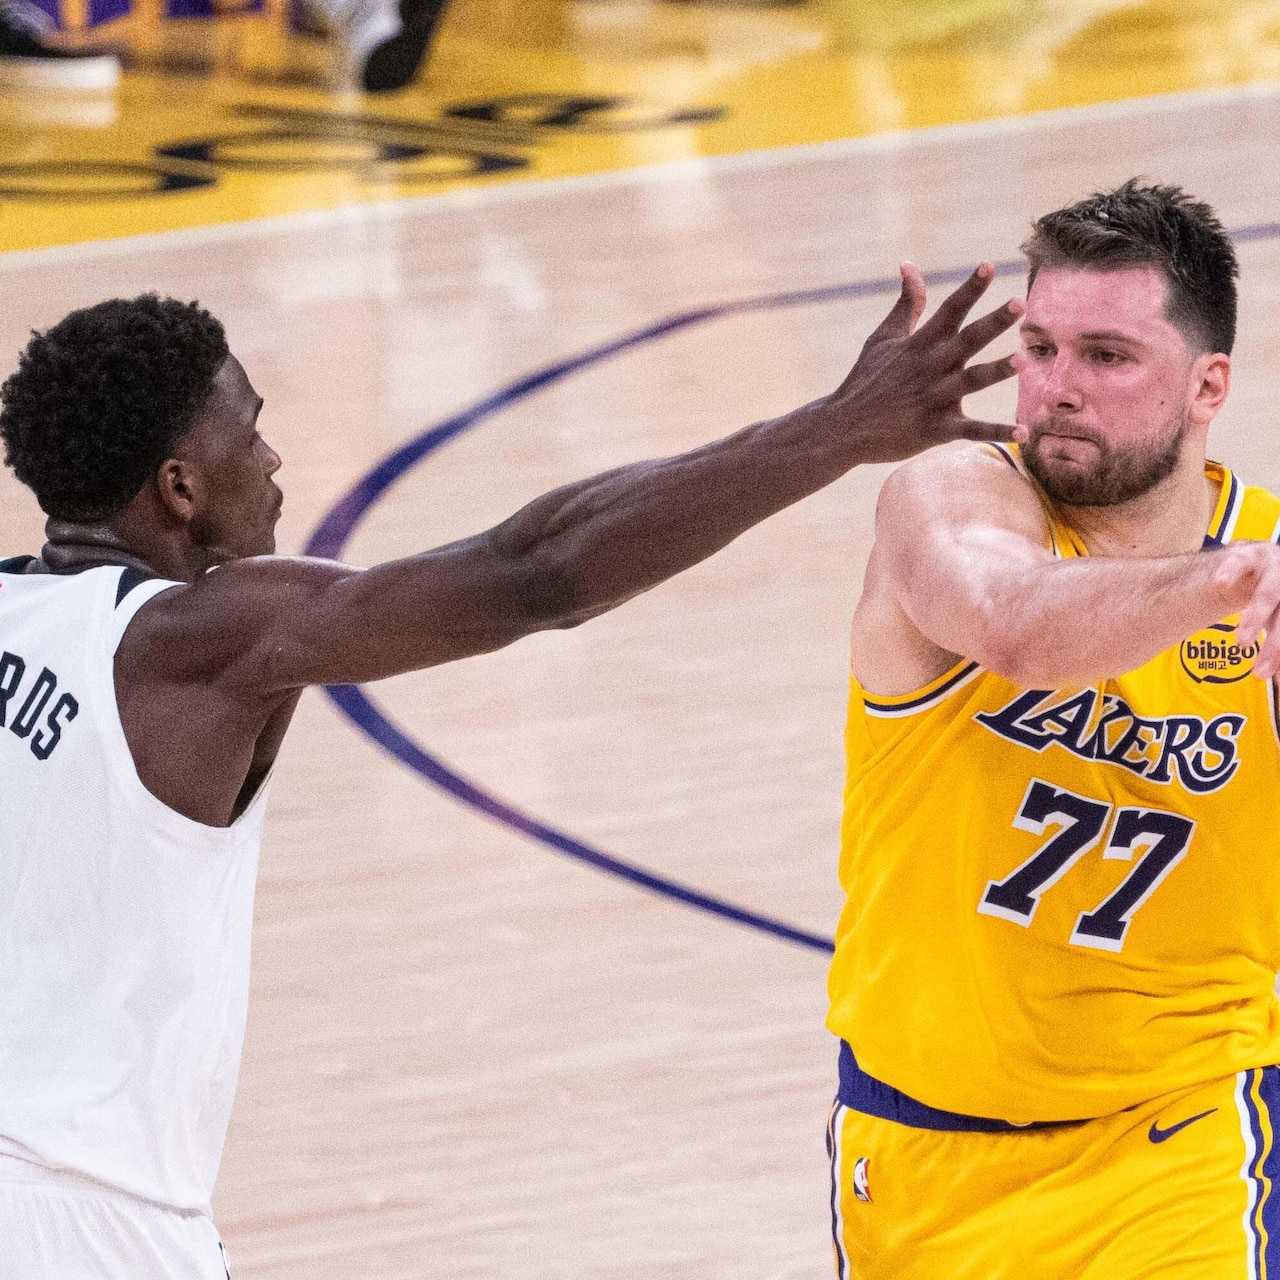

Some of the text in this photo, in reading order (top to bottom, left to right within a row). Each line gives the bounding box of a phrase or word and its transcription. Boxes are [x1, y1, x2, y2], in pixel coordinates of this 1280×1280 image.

[1186, 640, 1255, 666] bibigo
[1198, 660, 1227, 670] 비비고
[972, 684, 1248, 796] LAKERS
[977, 777, 1198, 953] 77
